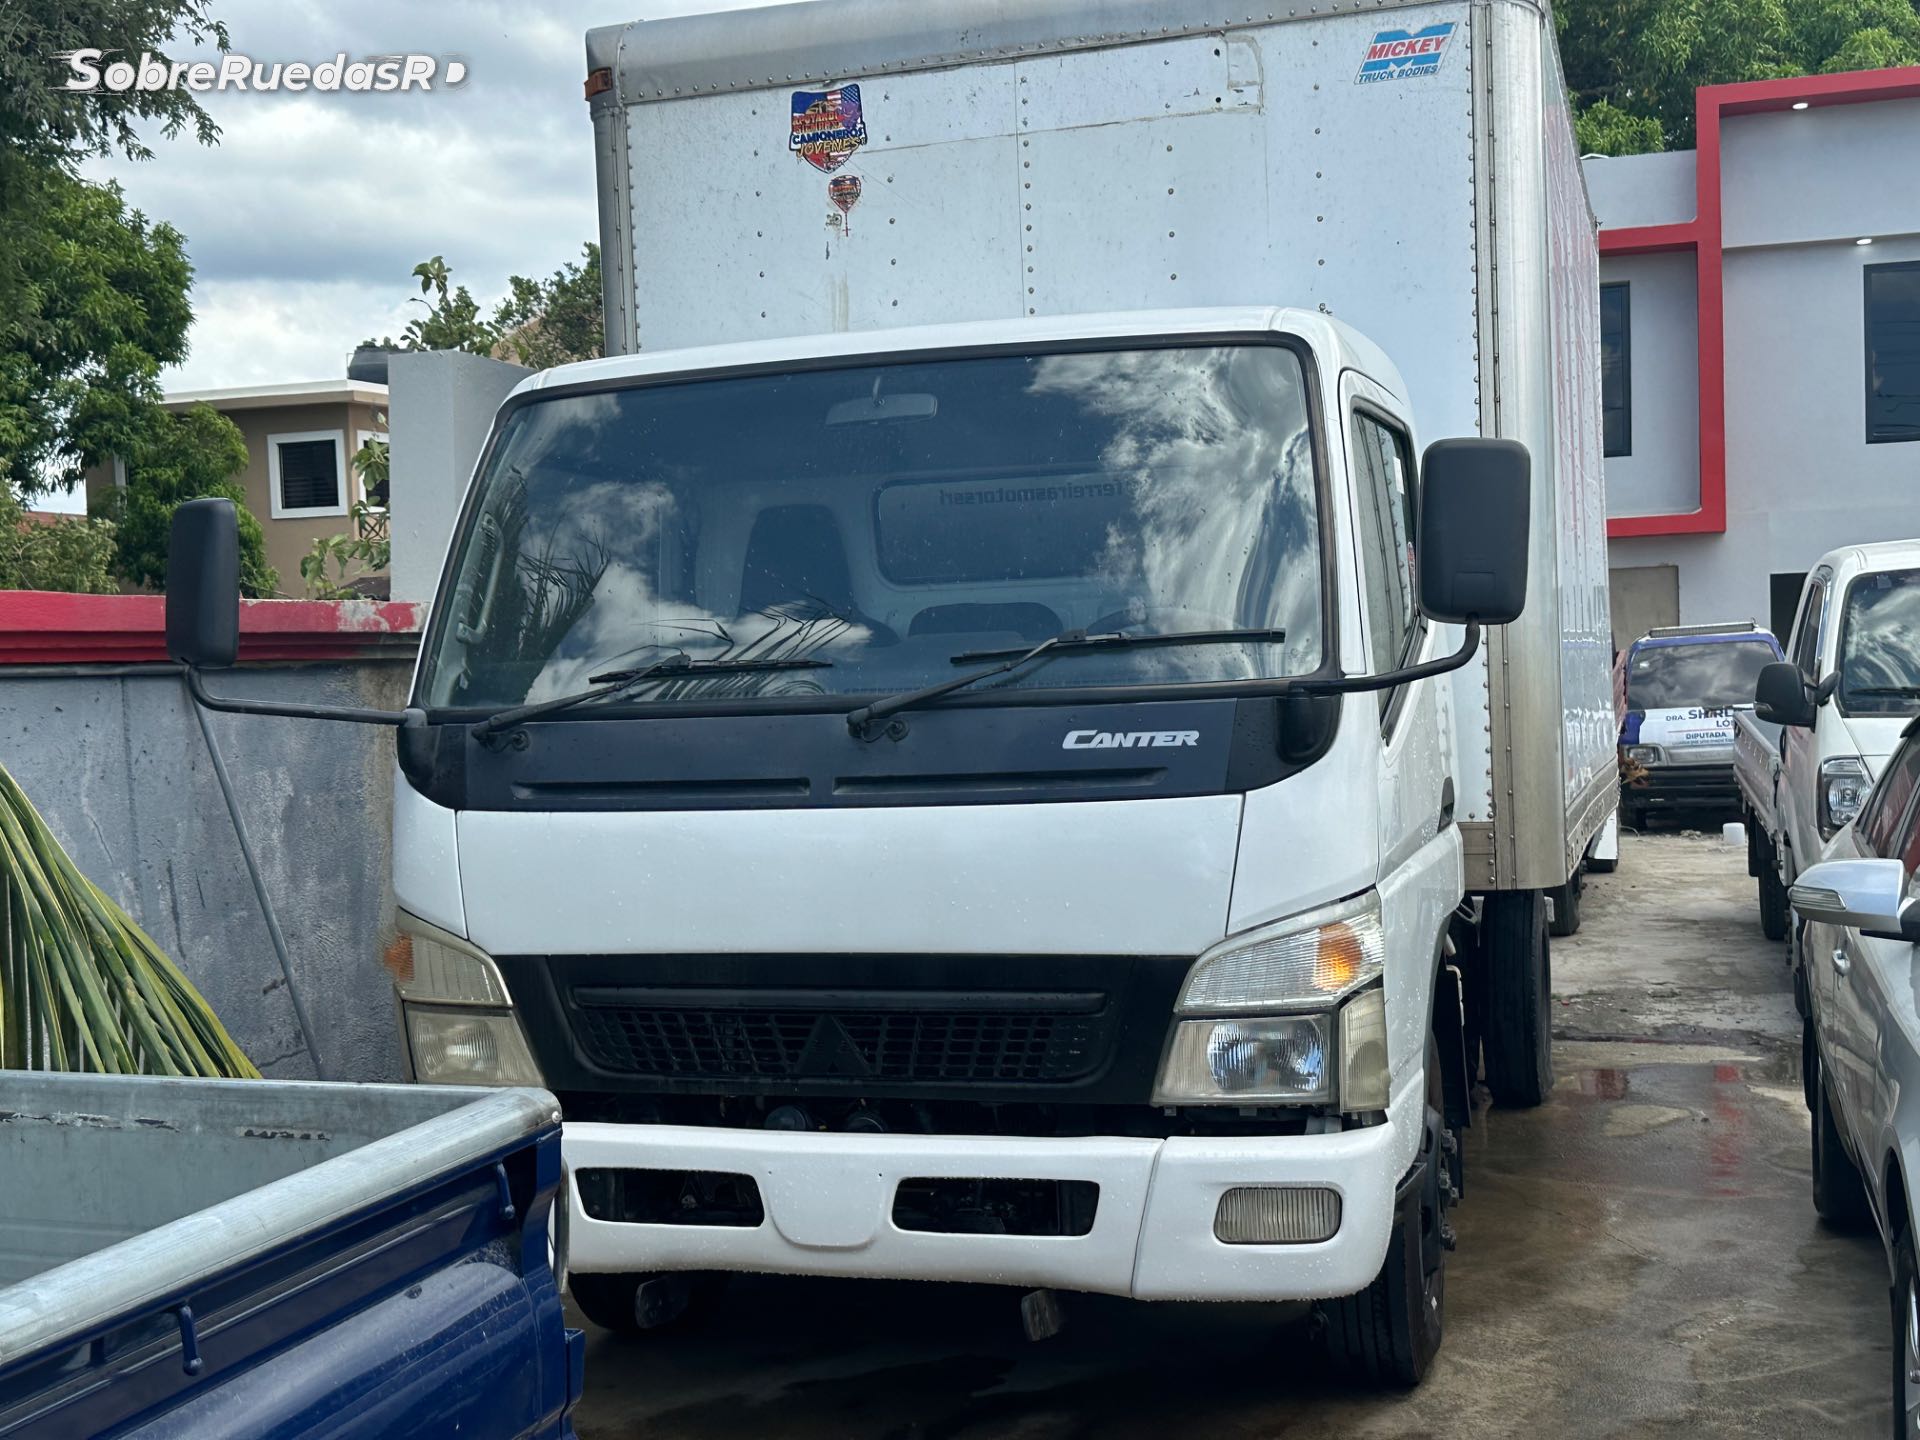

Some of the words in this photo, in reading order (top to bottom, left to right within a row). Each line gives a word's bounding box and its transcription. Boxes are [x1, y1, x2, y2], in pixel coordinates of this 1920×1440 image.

[1366, 36, 1447, 60] MICKEY
[1359, 69, 1395, 84] TRUCK
[1397, 64, 1438, 79] BODIES
[792, 127, 863, 145] CAMIONEROS
[797, 136, 859, 156] JOVENES
[1062, 729, 1200, 749] CANTER
[1685, 731, 1727, 739] DIPUTADA
